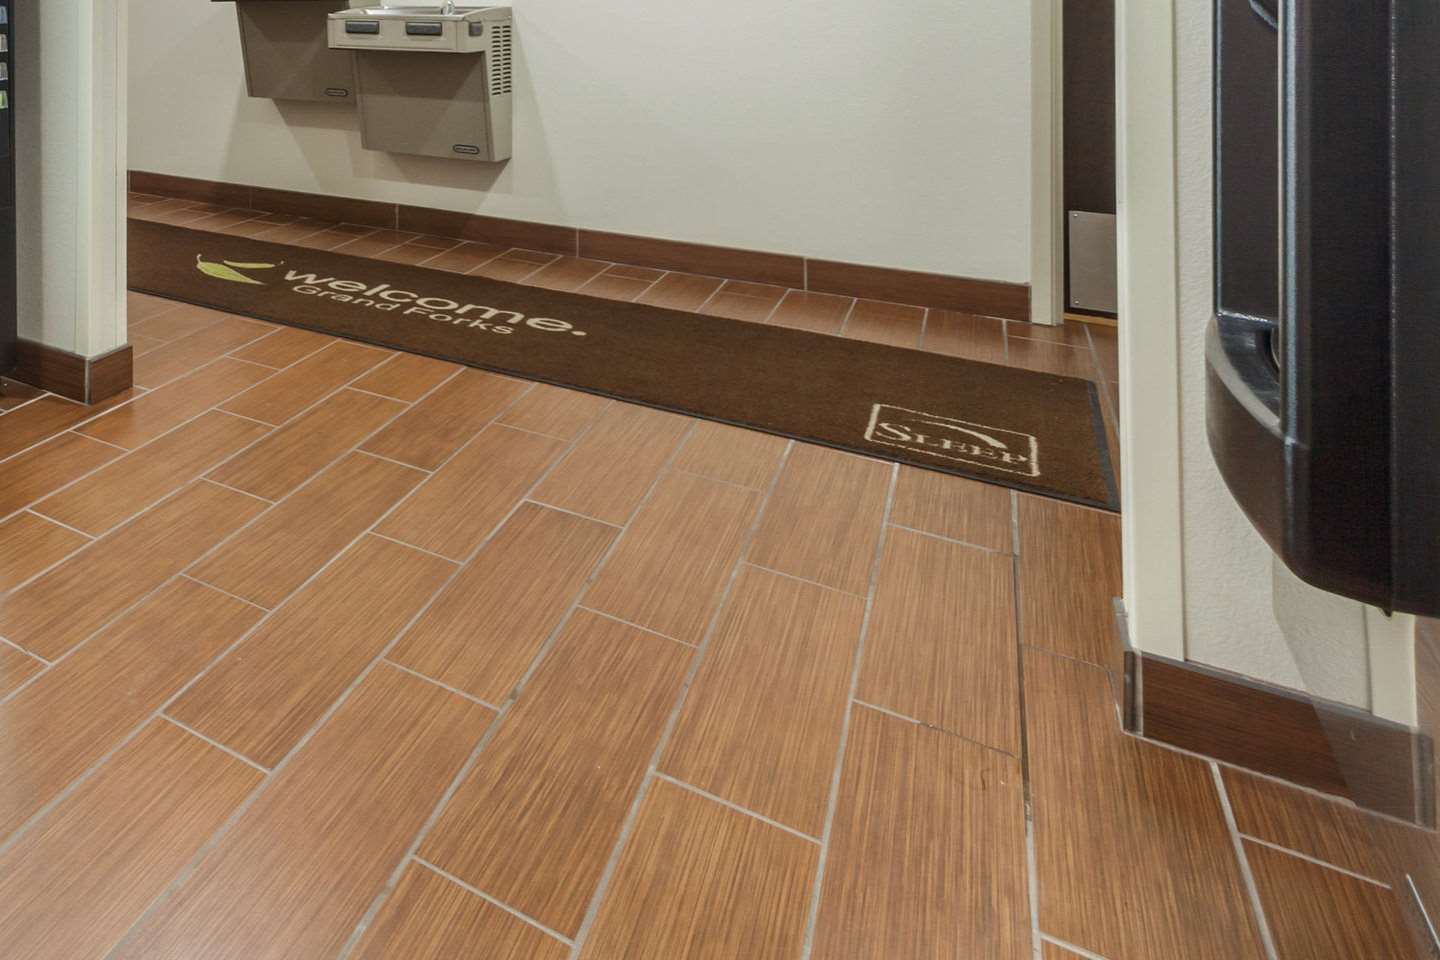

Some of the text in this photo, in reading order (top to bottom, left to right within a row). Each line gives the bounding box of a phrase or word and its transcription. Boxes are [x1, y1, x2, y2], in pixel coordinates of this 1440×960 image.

[283, 269, 588, 337] welcome.
[292, 284, 515, 336] Grand Forks
